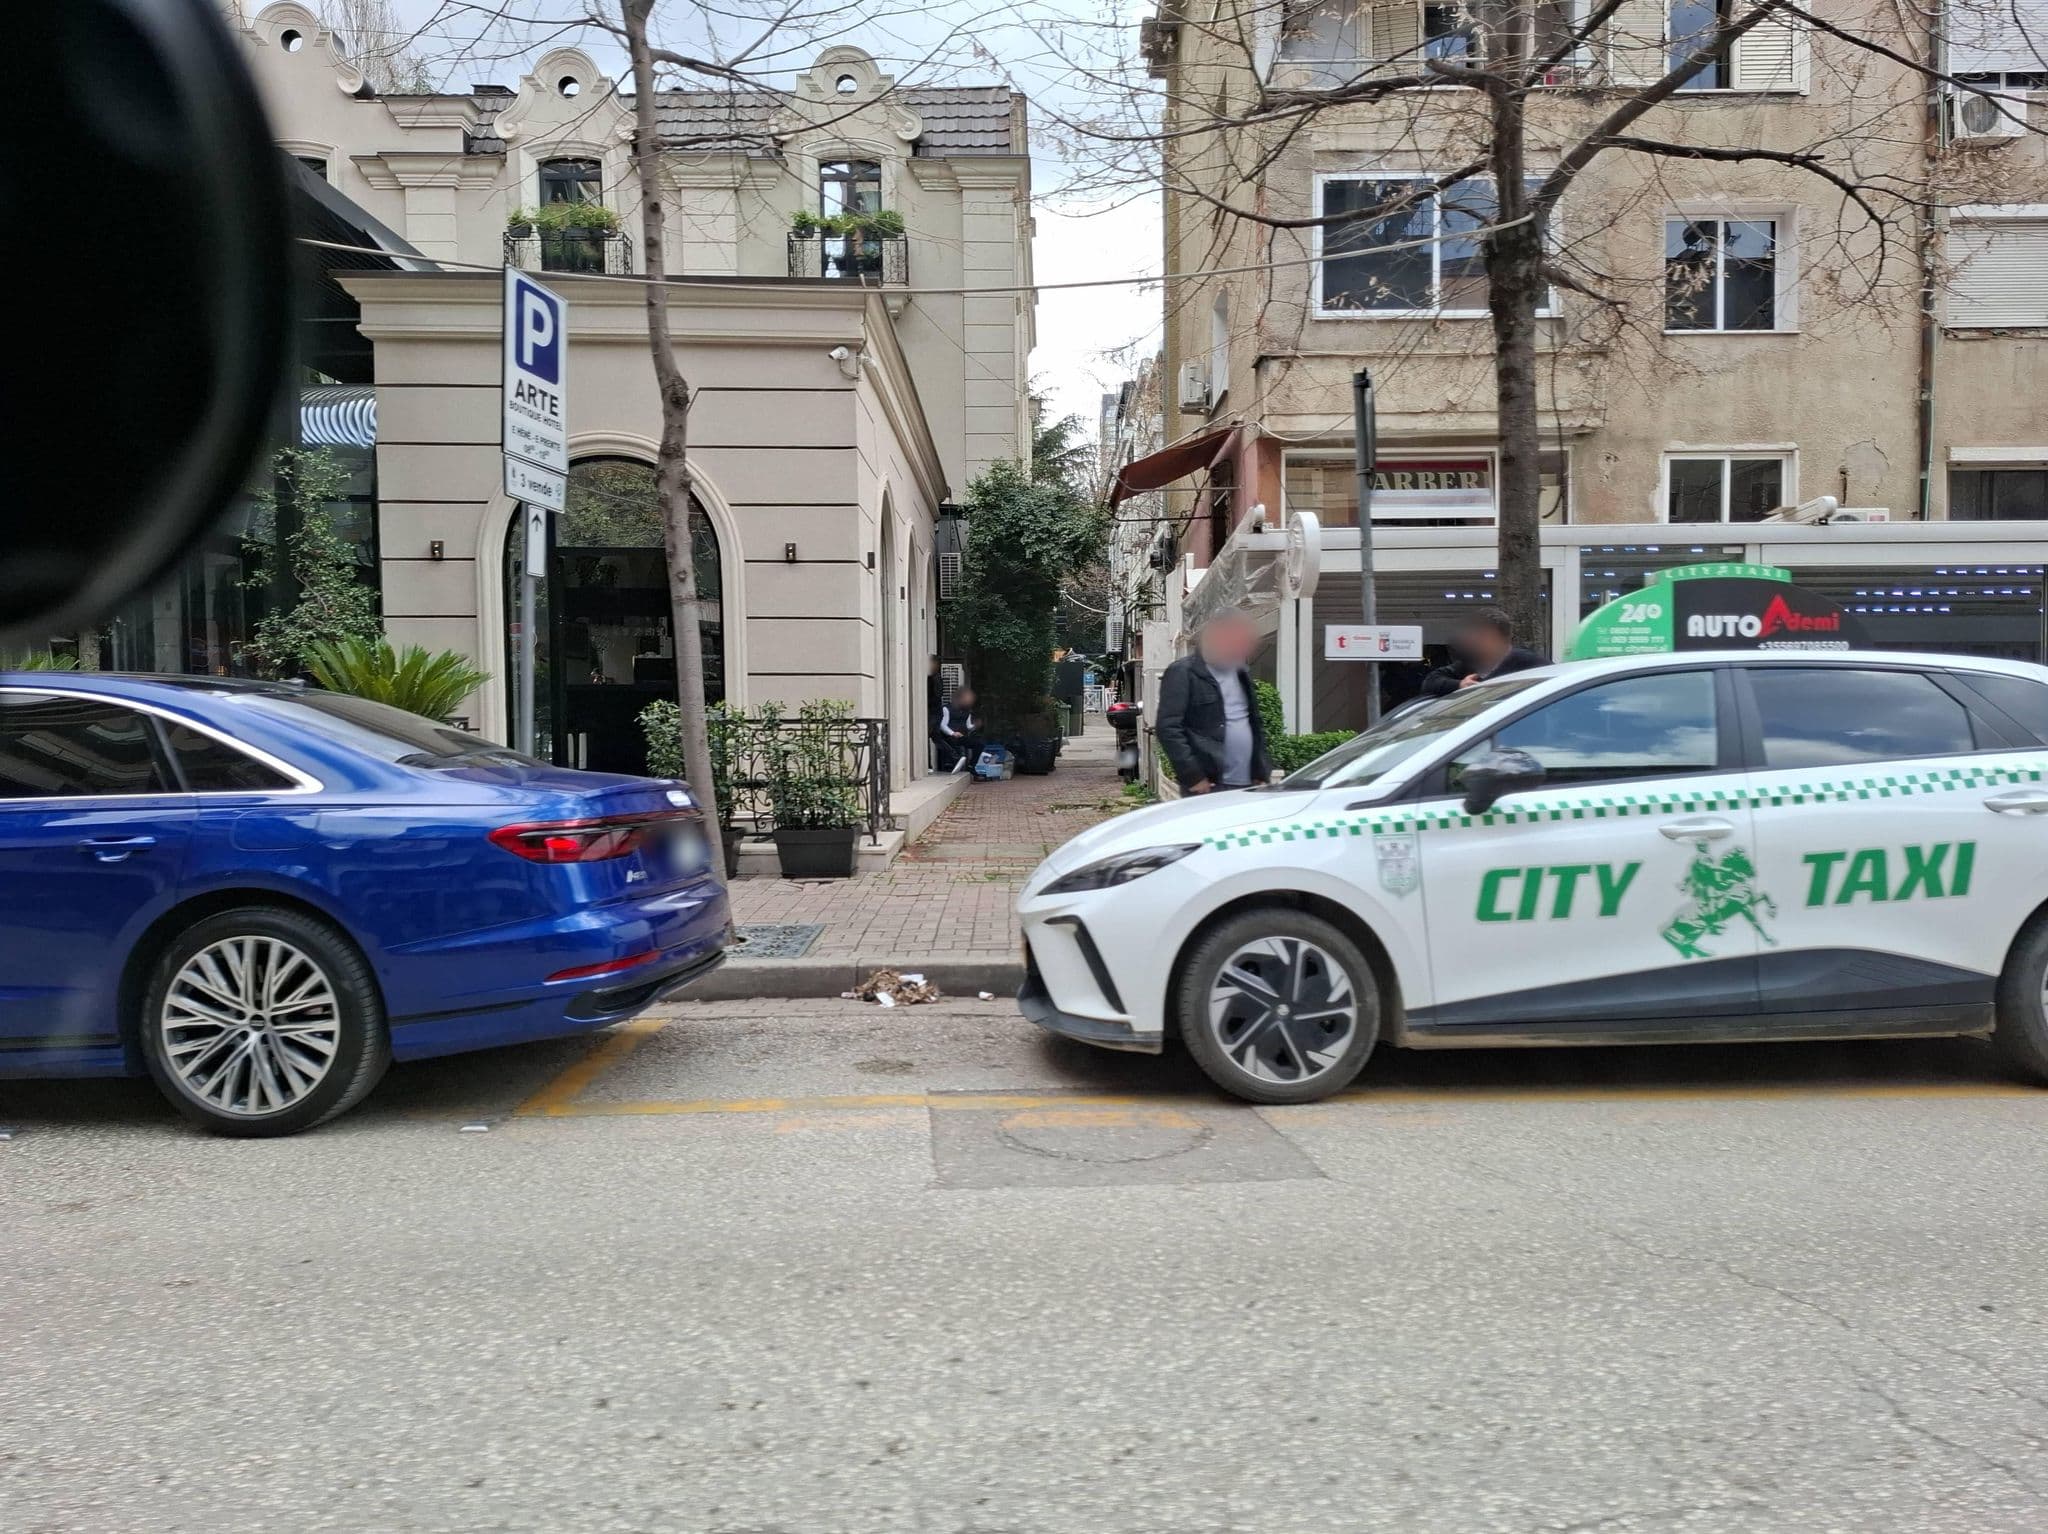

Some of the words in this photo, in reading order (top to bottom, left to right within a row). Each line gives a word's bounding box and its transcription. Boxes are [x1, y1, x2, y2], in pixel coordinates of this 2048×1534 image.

[522, 289, 554, 366] P
[514, 378, 560, 417] ARTE
[509, 400, 541, 422] BOUTIQUE
[542, 415, 563, 432] HOTEL
[520, 473, 526, 488] 3
[528, 480, 552, 497] vende
[1369, 470, 1489, 490] ARBER
[1735, 566, 1783, 578] TAXI
[1688, 615, 1762, 637] AUTO
[1759, 594, 1840, 638] Ademi
[1476, 862, 1642, 922] CITY
[1802, 842, 1976, 907] TAXI
